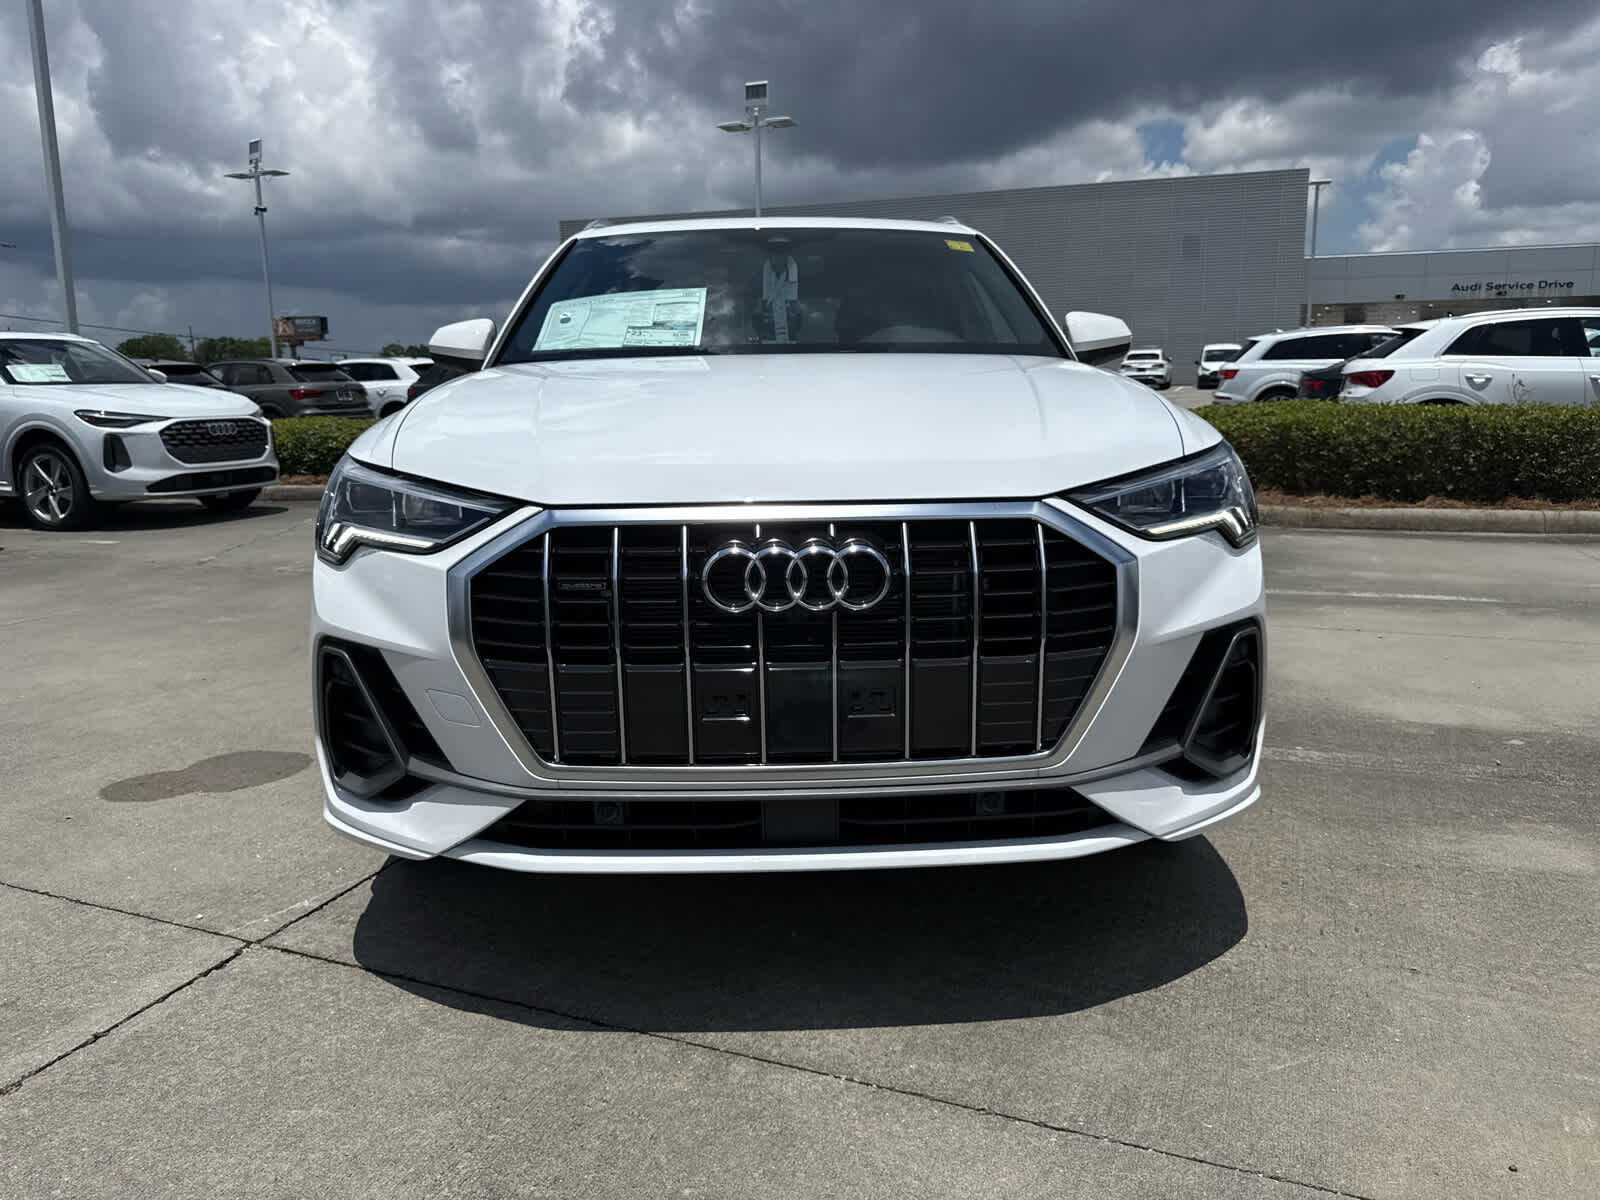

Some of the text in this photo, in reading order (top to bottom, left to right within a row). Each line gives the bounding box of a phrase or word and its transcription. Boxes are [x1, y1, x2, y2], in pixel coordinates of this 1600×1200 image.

[1451, 280, 1575, 292] Audi Service Drive
